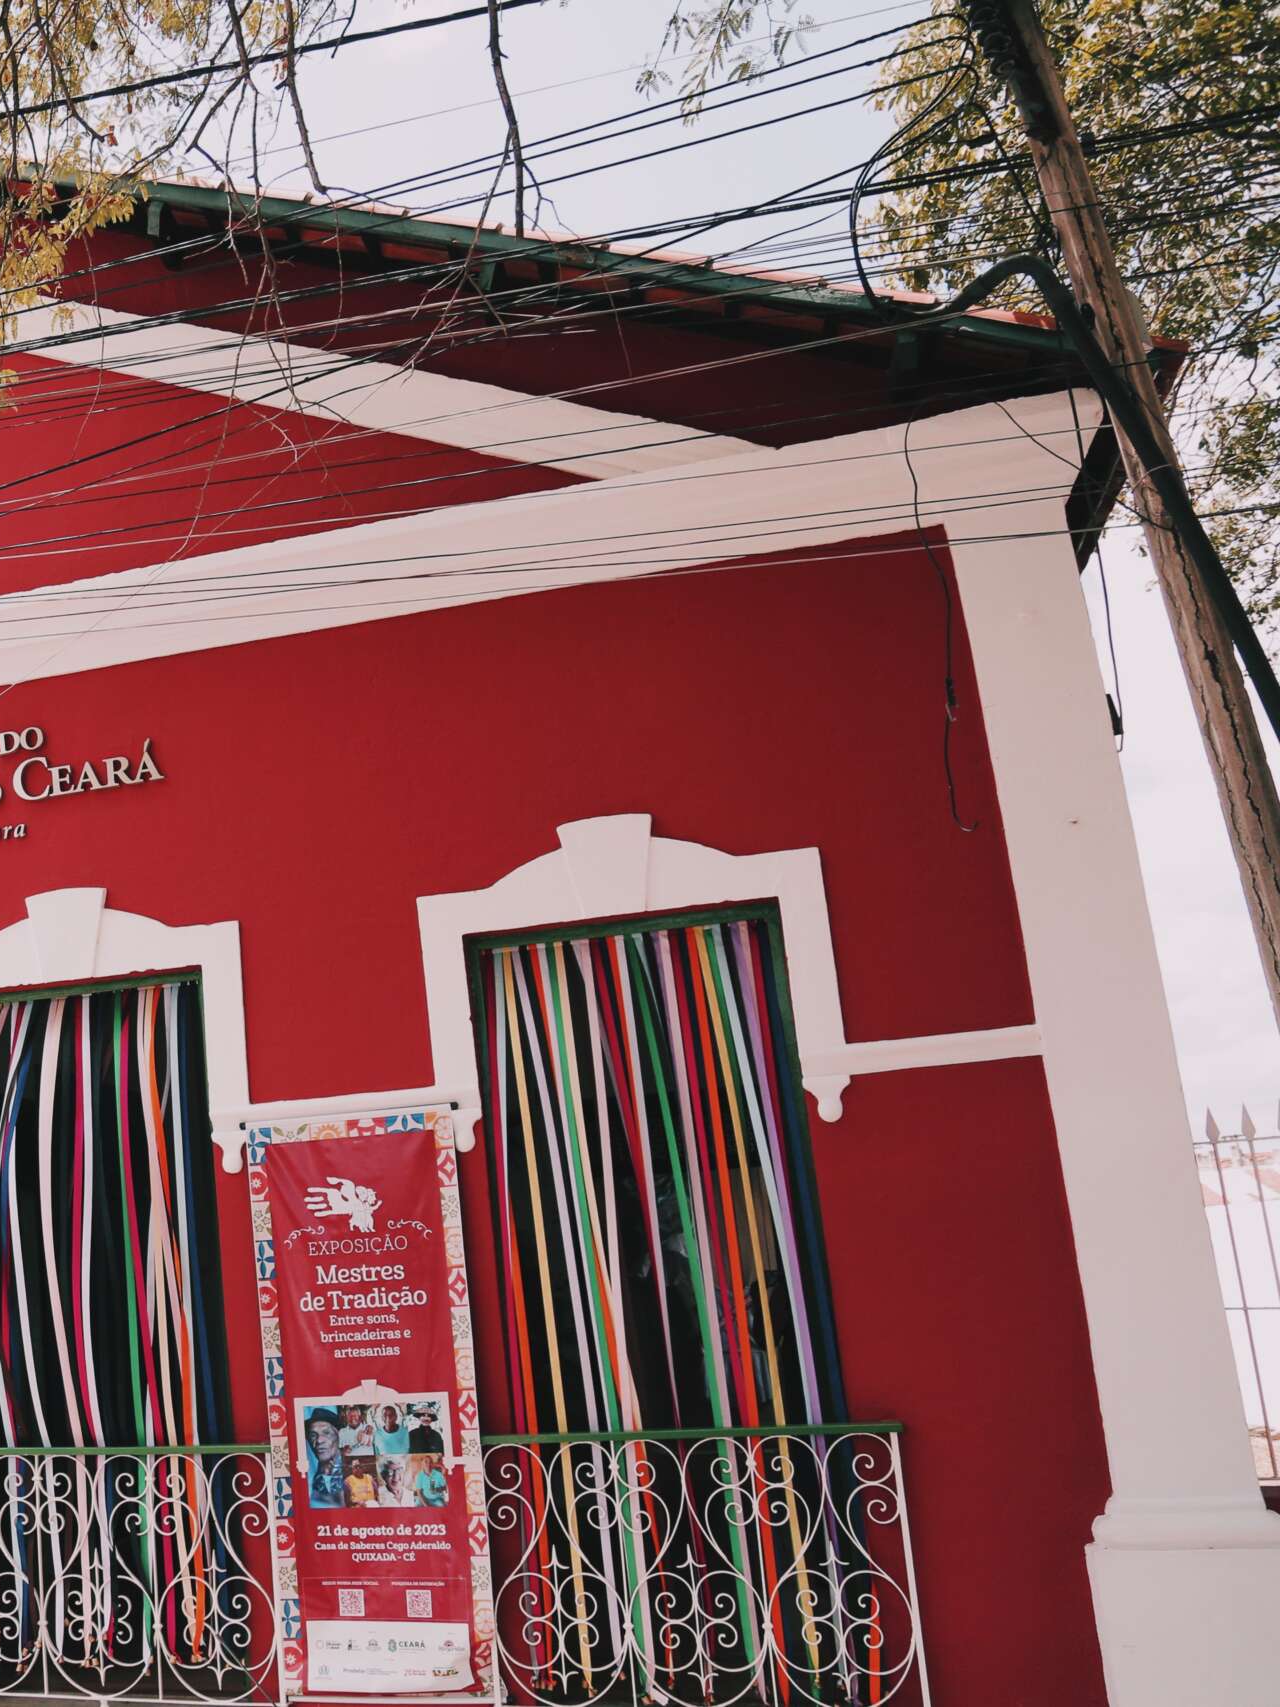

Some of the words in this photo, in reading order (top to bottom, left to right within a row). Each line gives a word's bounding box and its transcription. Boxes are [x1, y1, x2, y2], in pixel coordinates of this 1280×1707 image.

[13, 738, 164, 802] CEARÁ
[308, 1234, 408, 1256] EXPOSIÇÃO
[316, 1264, 404, 1285] Mestres
[300, 1292, 326, 1311] de
[328, 1287, 427, 1312] Tradição
[329, 1314, 364, 1326] Entre
[367, 1314, 400, 1326] sons,
[320, 1330, 400, 1342] brincadeiras
[404, 1330, 411, 1338] e
[334, 1345, 400, 1358] artesanias
[317, 1526, 331, 1536] 21
[334, 1525, 349, 1536] de
[352, 1526, 394, 1539] agosto
[397, 1524, 412, 1535] de
[414, 1524, 446, 1536] 2023
[314, 1542, 336, 1550] Casa
[338, 1542, 348, 1550] de
[350, 1541, 385, 1550] Saberes
[386, 1542, 409, 1551] Cego
[410, 1541, 451, 1550] Aderaldo
